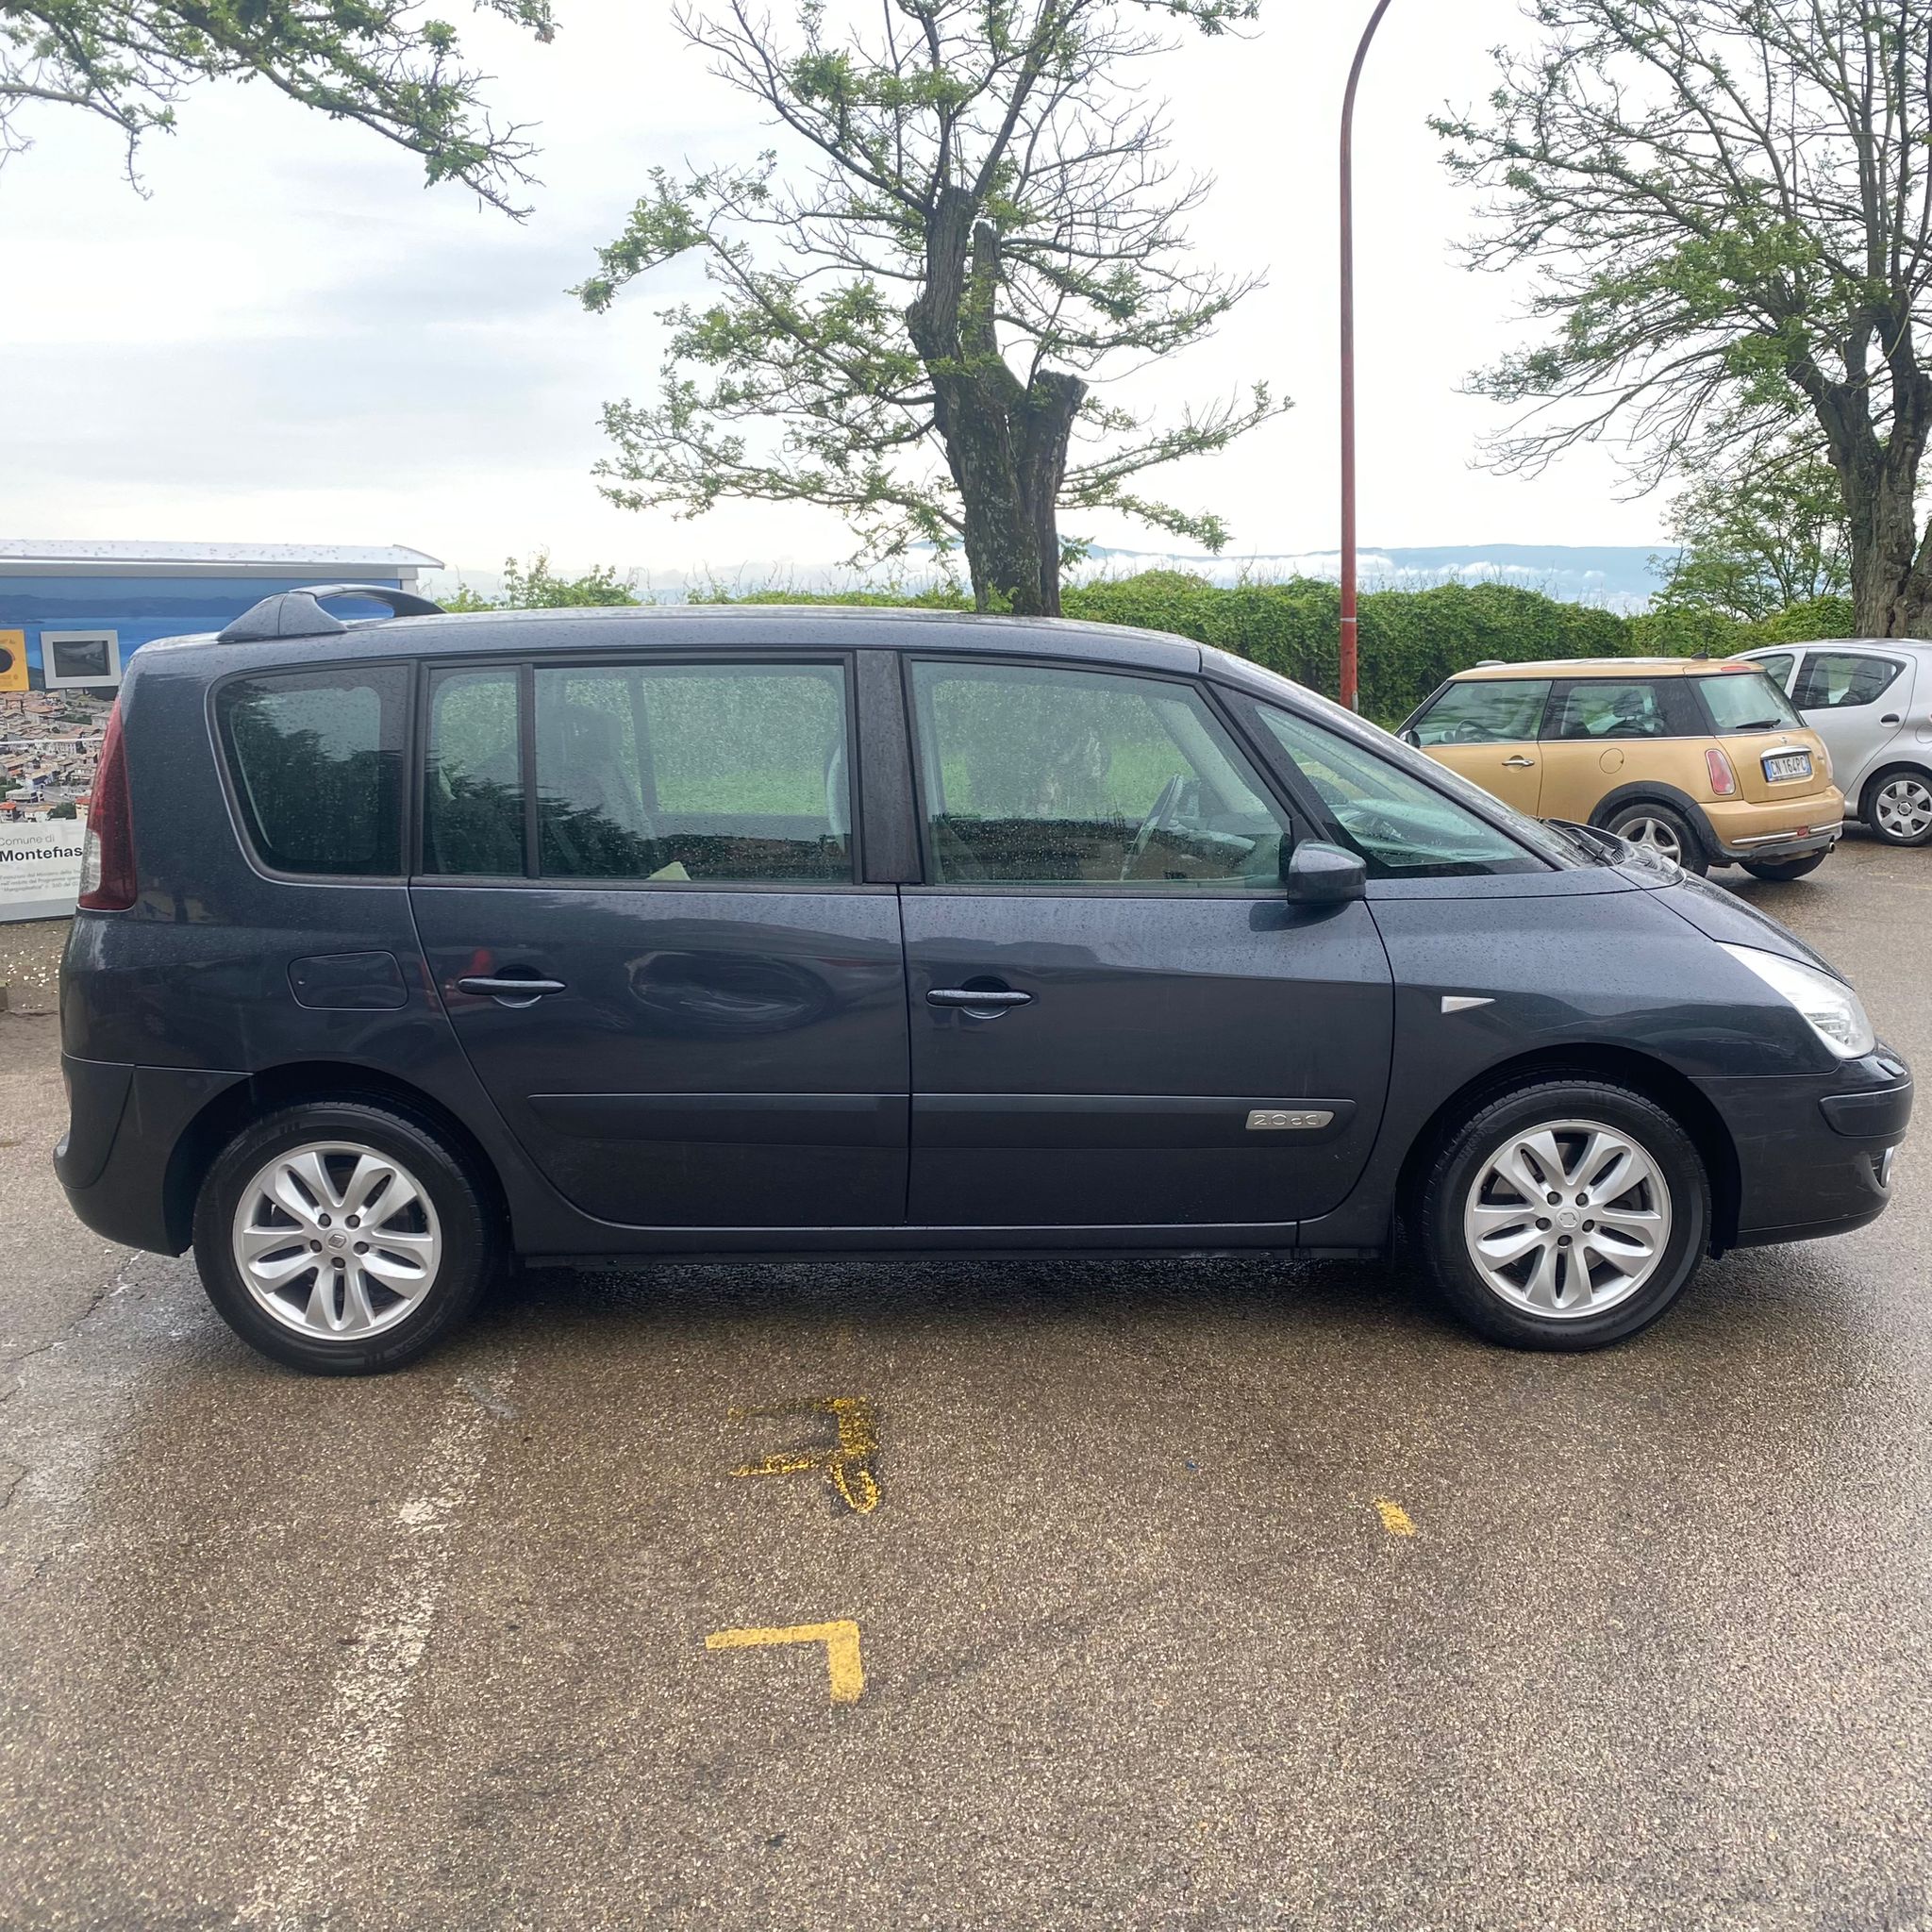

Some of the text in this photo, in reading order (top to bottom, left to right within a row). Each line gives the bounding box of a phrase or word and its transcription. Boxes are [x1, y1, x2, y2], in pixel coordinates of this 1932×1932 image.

[1771, 760, 1782, 775] CN
[1783, 757, 1807, 774] 164PC
[0, 834, 55, 846] Comune di
